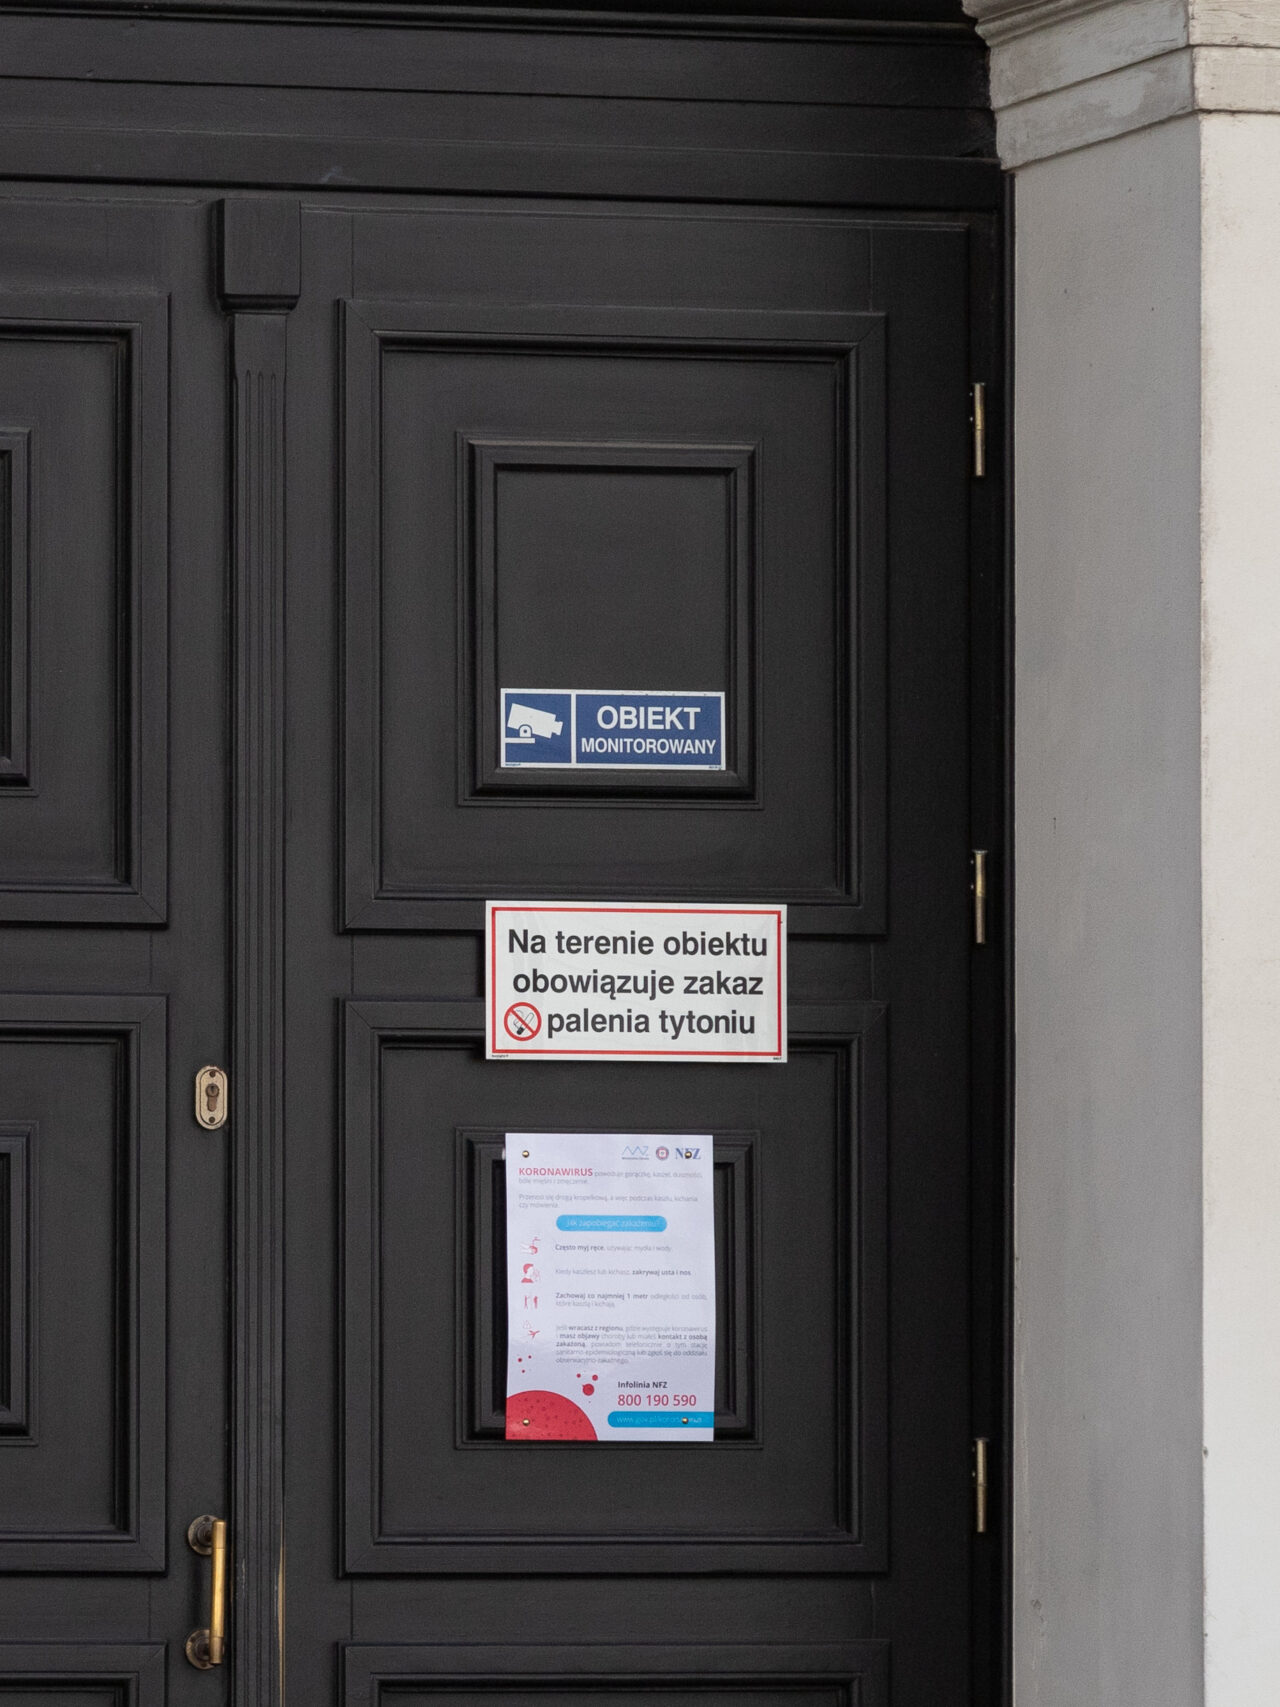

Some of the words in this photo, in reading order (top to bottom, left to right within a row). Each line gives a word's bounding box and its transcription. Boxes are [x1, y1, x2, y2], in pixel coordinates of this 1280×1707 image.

[596, 705, 701, 730] OBIEKT
[581, 737, 717, 755] MONITOROWANY
[508, 929, 546, 954] Na
[556, 931, 654, 955] terenie
[663, 932, 768, 957] obiektu
[512, 969, 675, 1001] obowiązuje
[683, 971, 764, 996] zakaz
[547, 1008, 650, 1039] palenia
[658, 1010, 755, 1040] tytoniu
[518, 1167, 593, 1177] KORONAWIRUS
[617, 1381, 651, 1389] Infolinia
[652, 1381, 668, 1389] NFZ
[617, 1394, 642, 1407] 800
[647, 1394, 670, 1407] 190
[672, 1394, 697, 1407] 590
